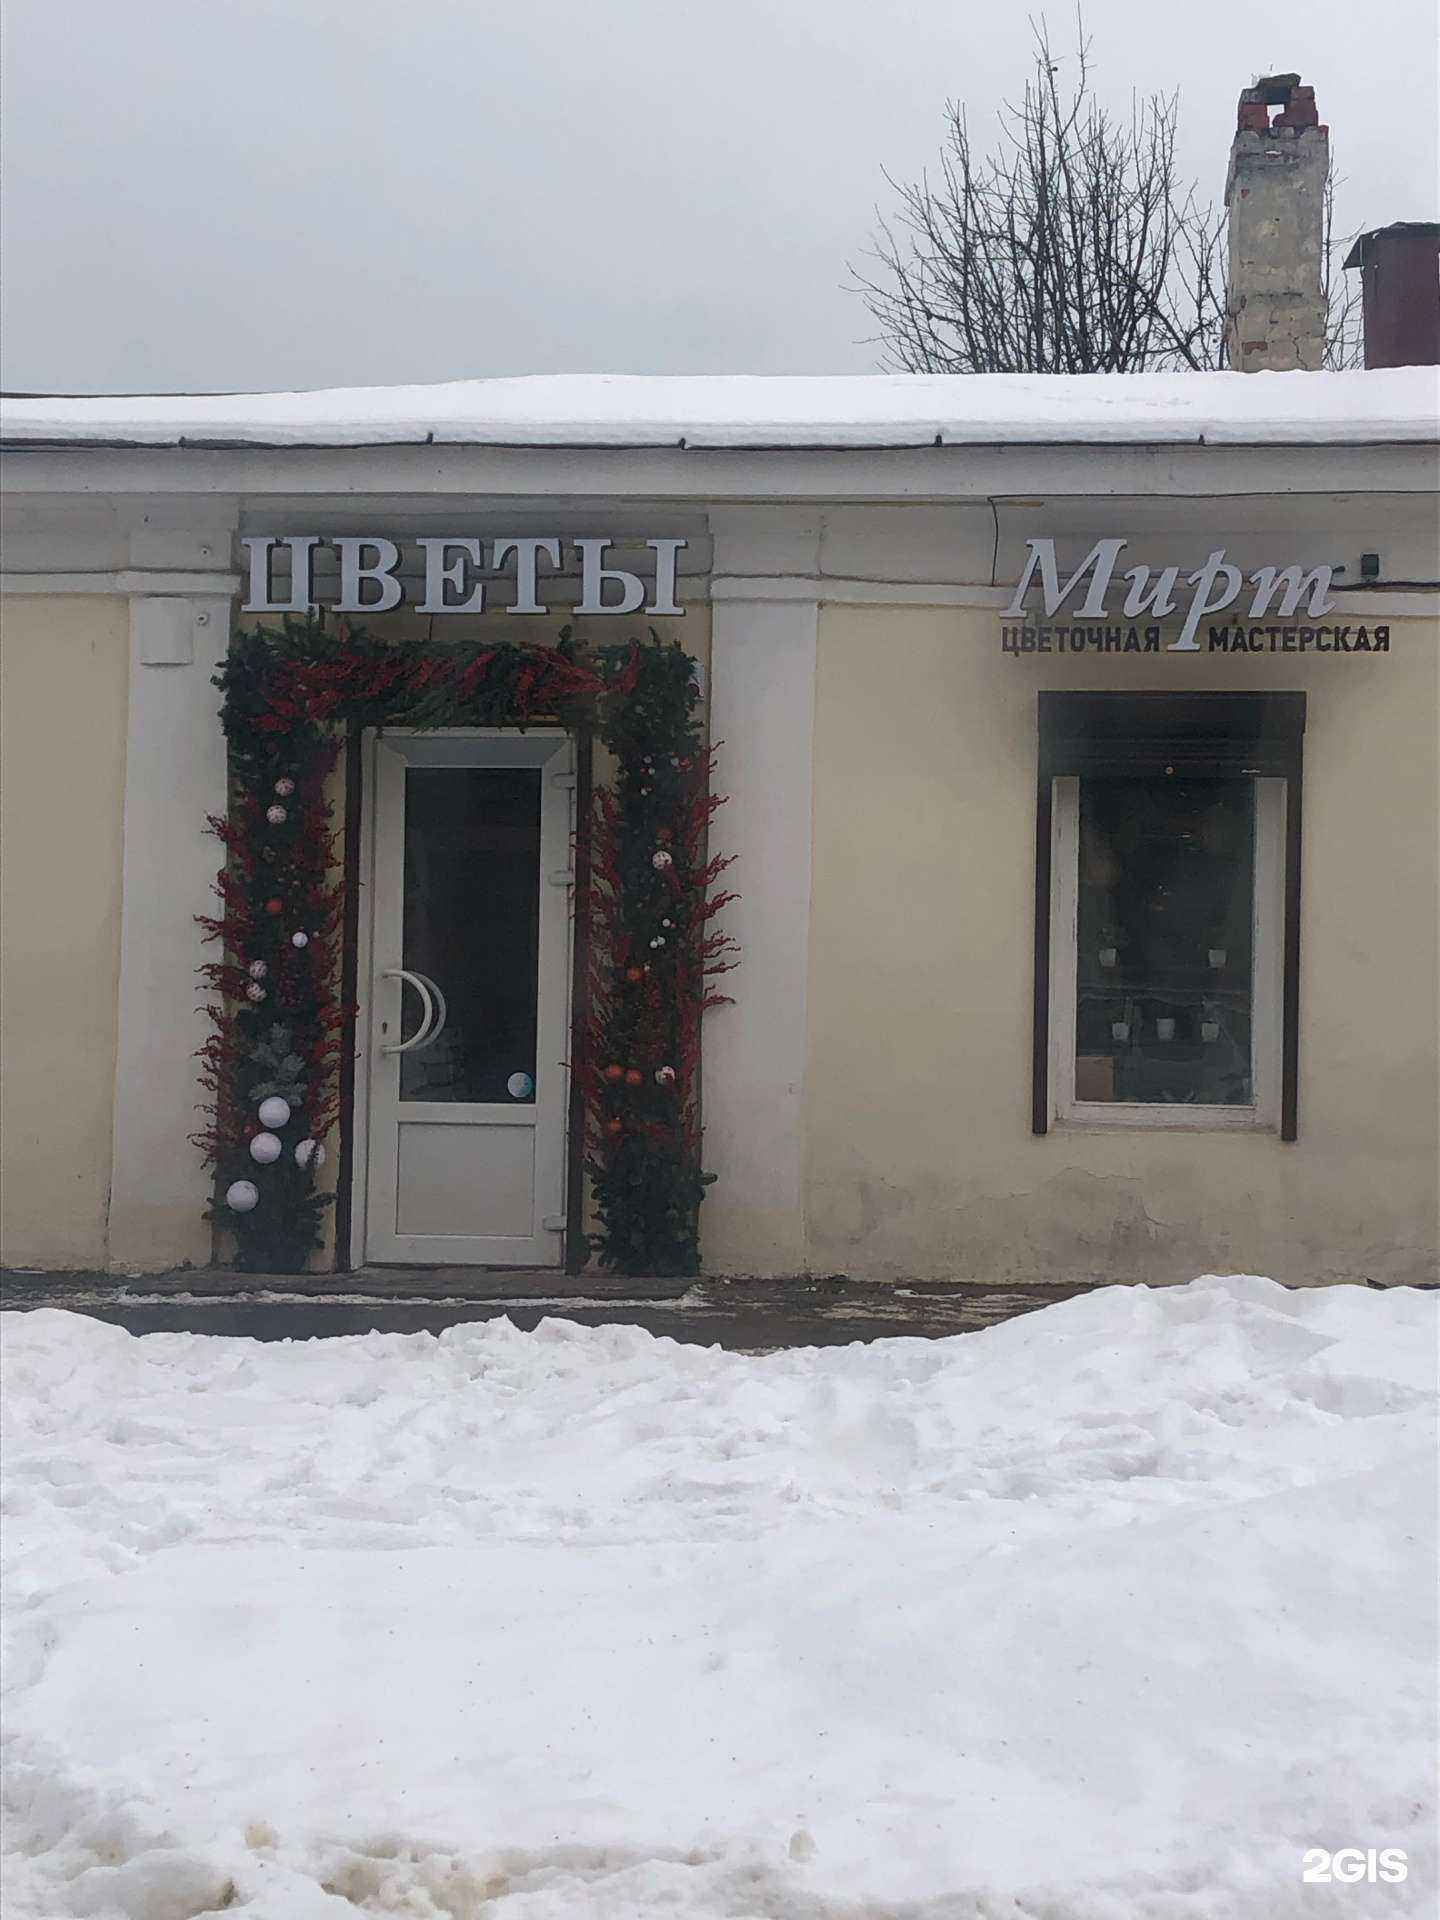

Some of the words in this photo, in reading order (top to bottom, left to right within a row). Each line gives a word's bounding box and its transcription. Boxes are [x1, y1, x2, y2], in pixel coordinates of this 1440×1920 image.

[241, 536, 687, 617] ЦВЕТЫ
[1000, 537, 1337, 652] Мирт
[1001, 626, 1160, 656] ЦВЕТОЧНАЯ
[1208, 625, 1391, 653] МАСТЕРСКАЯ
